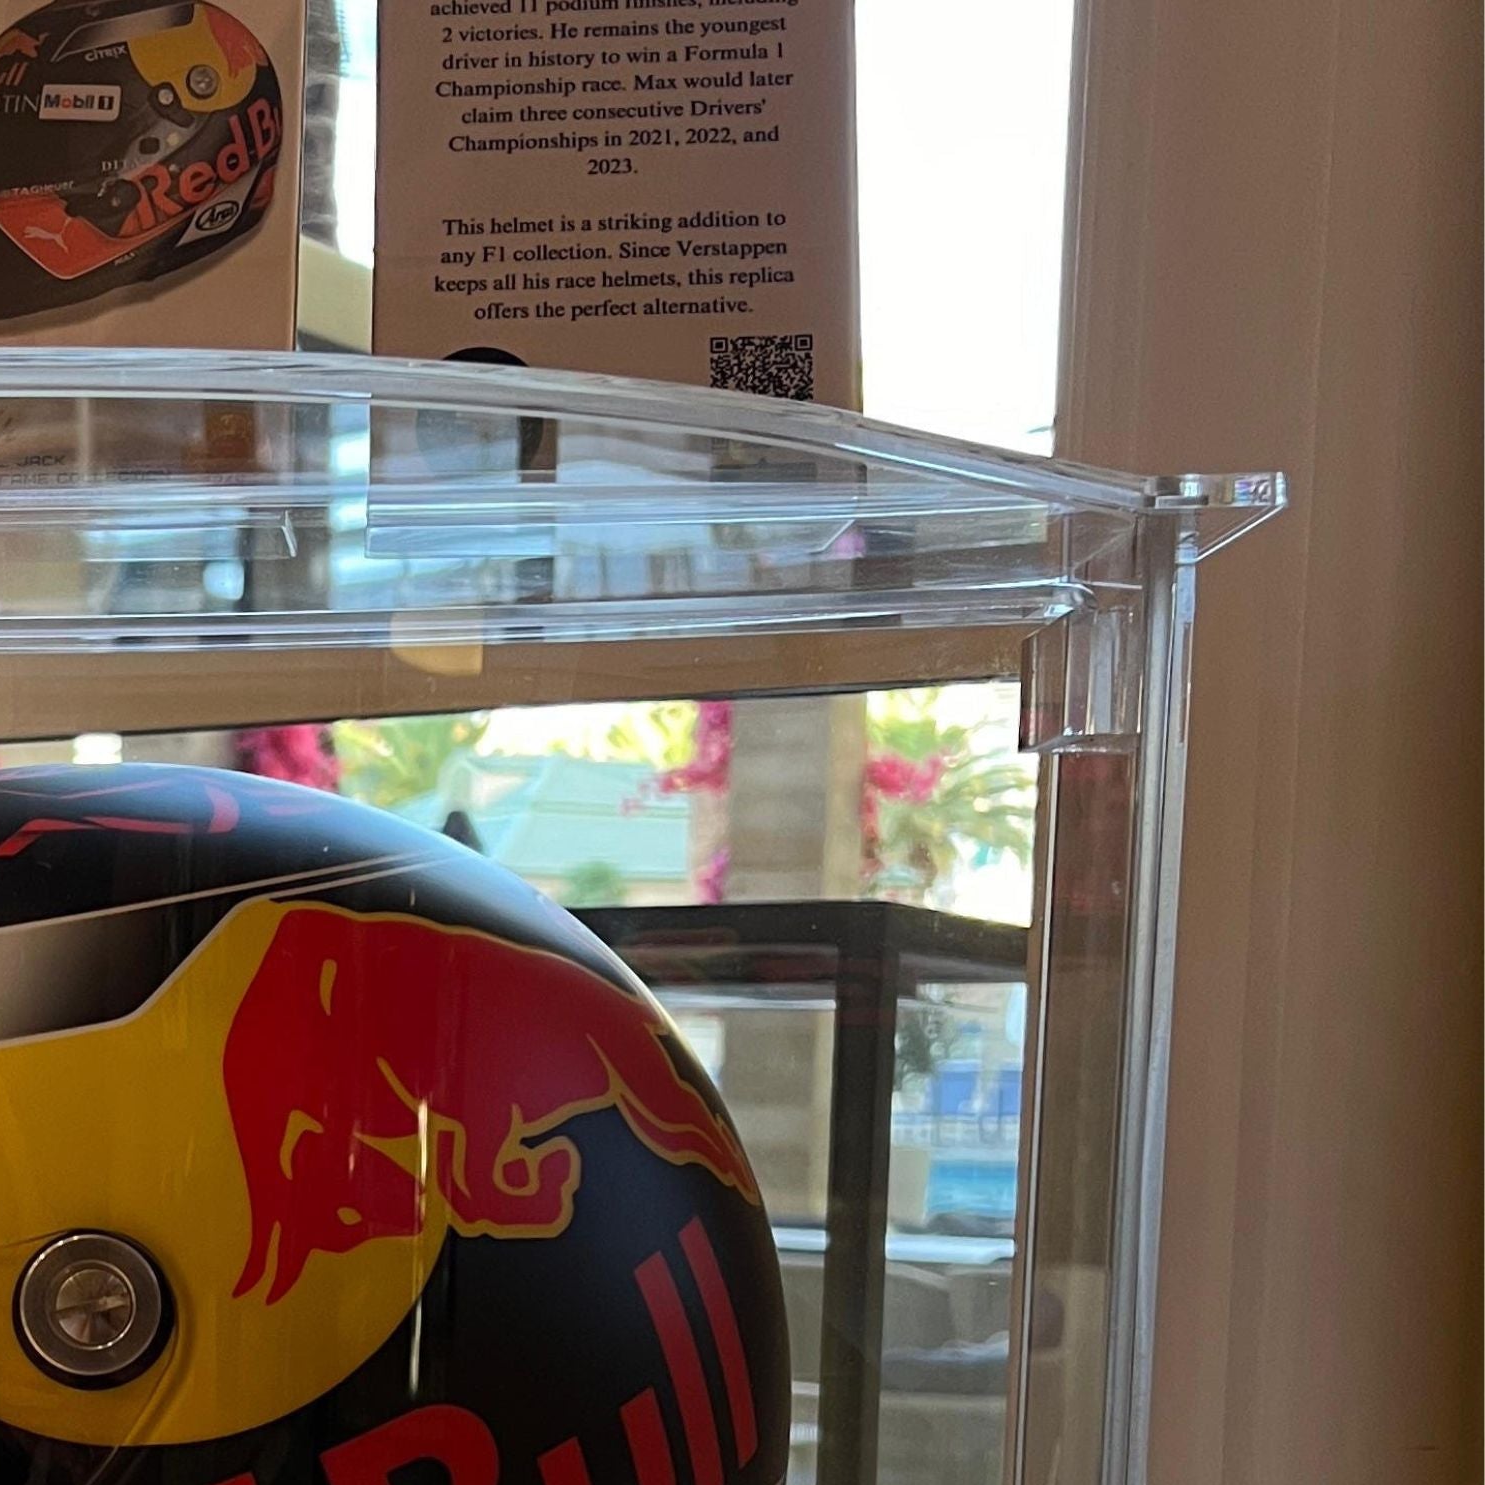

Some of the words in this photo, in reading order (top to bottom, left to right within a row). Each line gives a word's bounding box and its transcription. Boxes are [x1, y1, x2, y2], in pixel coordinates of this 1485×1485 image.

[430, 0, 512, 16] achieved
[520, 0, 537, 12] 11
[545, 0, 619, 16] podium
[442, 27, 453, 43] 2
[459, 24, 544, 43] victories.
[550, 22, 579, 39] He
[583, 20, 659, 38] remains
[665, 19, 695, 35] the
[700, 17, 787, 38] youngest
[442, 53, 500, 70] driver
[505, 52, 522, 68] in
[528, 51, 595, 69] history
[601, 51, 621, 65] to
[626, 47, 661, 63] win
[666, 50, 678, 63] a
[684, 42, 769, 62] Formula
[777, 42, 784, 59] 1
[435, 77, 576, 99] Championship
[582, 80, 627, 92] race.
[633, 74, 677, 91] Max
[683, 71, 743, 88] would
[750, 71, 794, 87] later
[461, 107, 513, 124] claim
[520, 106, 568, 122] three
[572, 101, 684, 120] consecutive
[690, 98, 767, 116] Drivers'
[448, 131, 599, 154] Championships
[604, 131, 622, 147] in
[628, 129, 680, 147] 2021,
[685, 127, 737, 145] 2022,
[743, 125, 780, 142] and
[118, 114, 251, 231] Red
[246, 97, 281, 161] B
[587, 158, 639, 175] 2023.
[442, 218, 485, 236] This
[490, 217, 554, 234] helmet
[560, 214, 576, 232] is
[581, 219, 592, 232] a
[598, 213, 672, 233] striking
[677, 211, 759, 228] addition
[766, 212, 787, 226] to
[440, 251, 476, 267] any
[482, 246, 505, 263] F1
[513, 244, 612, 262] collection.
[619, 242, 671, 259] Since
[676, 240, 788, 260] Verstappen
[434, 275, 488, 295] keeps
[493, 274, 516, 290] all
[522, 272, 550, 289] his
[556, 275, 596, 289] race
[602, 270, 682, 288] helmets,
[688, 267, 724, 285] this
[729, 266, 795, 288] replica
[474, 302, 529, 320] offers
[535, 301, 566, 318] the
[571, 300, 637, 321] perfect
[642, 296, 755, 316] alternative.
